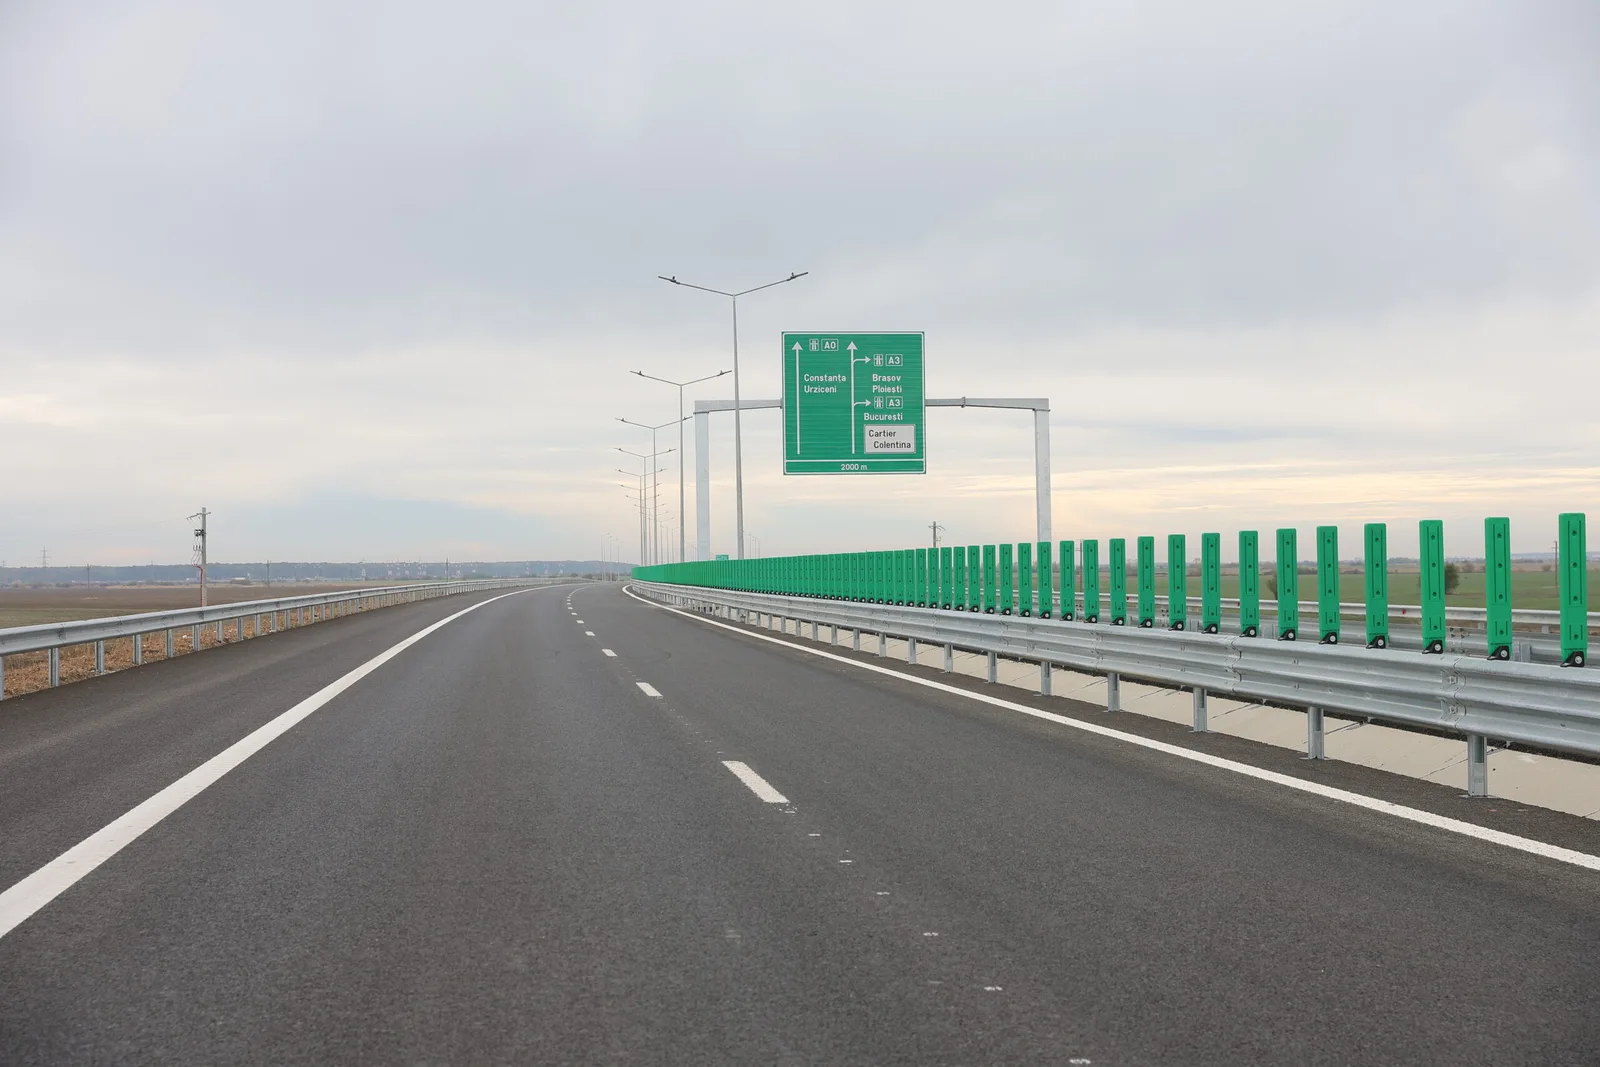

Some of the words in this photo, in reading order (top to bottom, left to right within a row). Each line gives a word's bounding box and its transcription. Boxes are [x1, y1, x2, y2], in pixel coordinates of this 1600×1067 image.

[824, 341, 836, 350] A0
[888, 356, 900, 364] A3
[888, 398, 901, 406] A3
